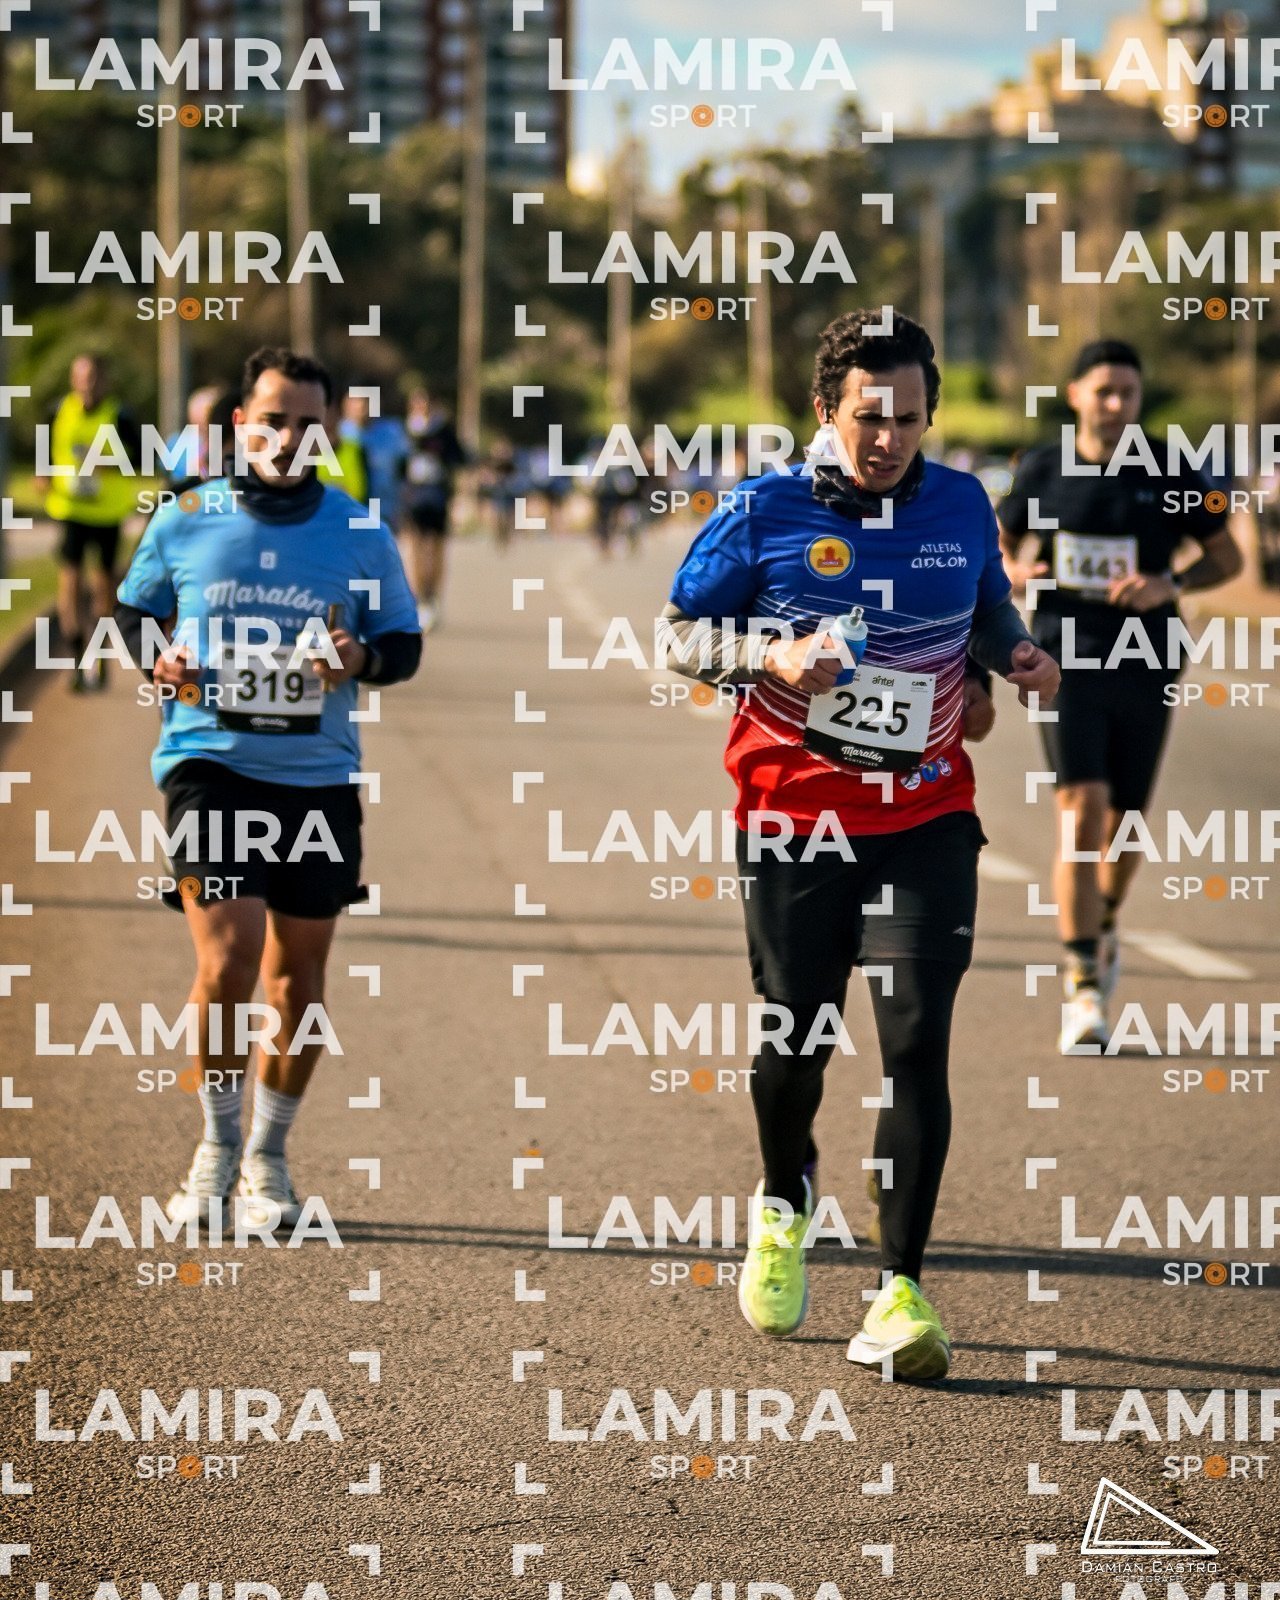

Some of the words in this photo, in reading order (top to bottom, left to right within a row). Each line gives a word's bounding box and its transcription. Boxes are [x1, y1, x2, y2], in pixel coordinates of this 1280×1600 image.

[920, 543, 962, 554] ATLETAS
[203, 579, 325, 616] Maratón
[237, 670, 304, 703] 319
[871, 675, 895, 687] antel
[829, 691, 911, 736] 225
[841, 745, 884, 763] Maratón
